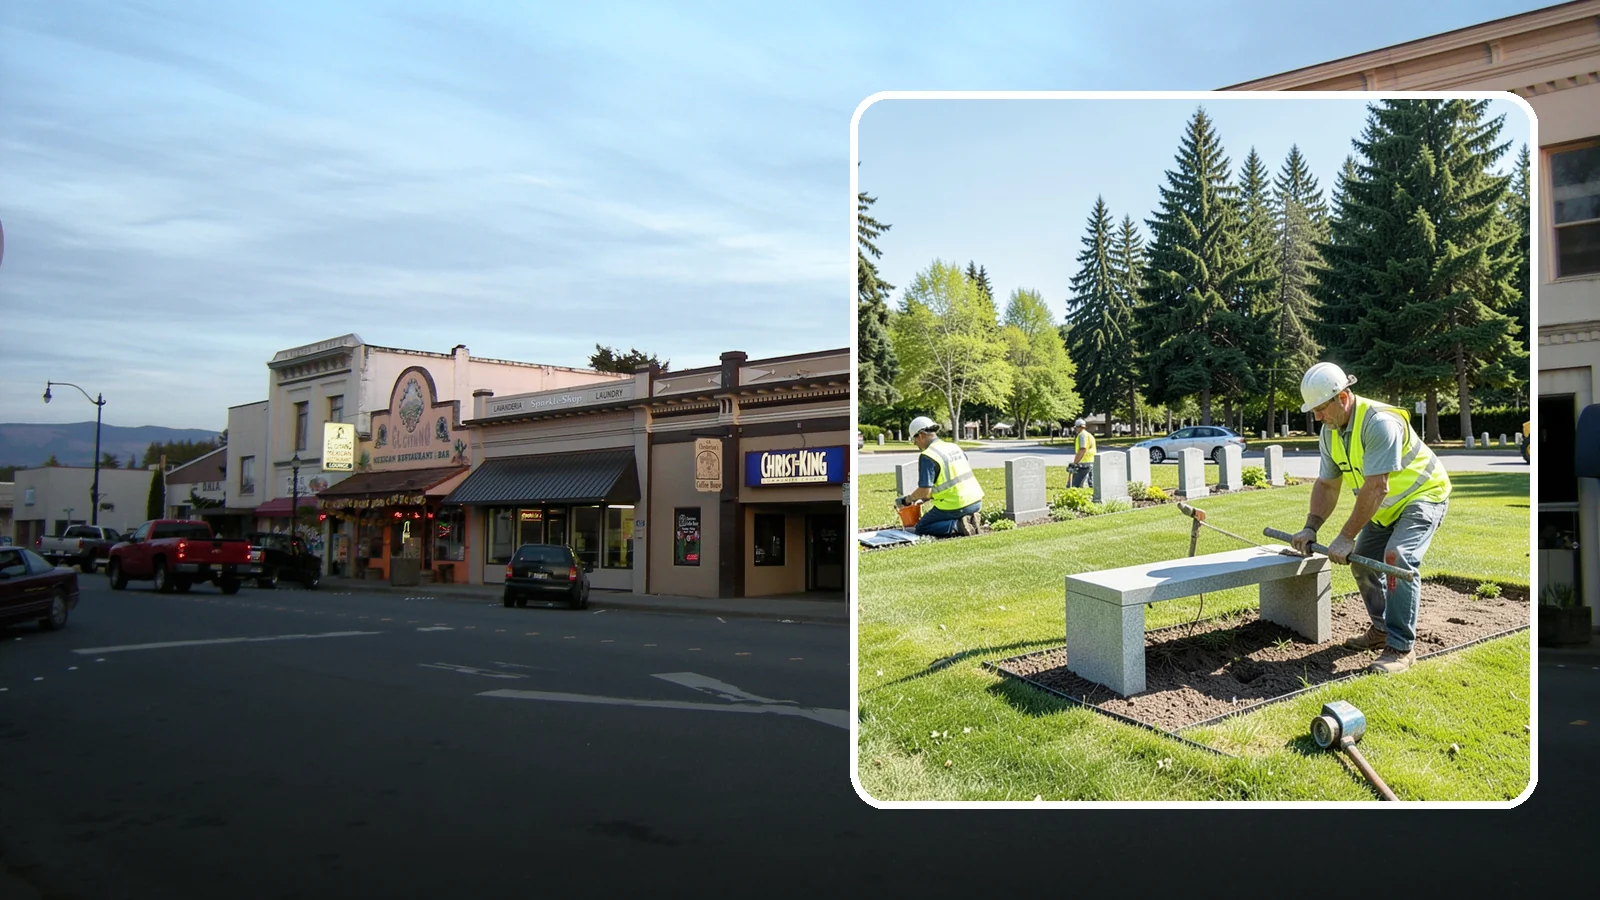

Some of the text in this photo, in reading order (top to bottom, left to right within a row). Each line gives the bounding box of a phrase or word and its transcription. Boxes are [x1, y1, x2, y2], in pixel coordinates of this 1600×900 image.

[595, 389, 623, 400] LAUNDRY
[493, 402, 522, 412] LAVANDERIA
[530, 394, 582, 409] Sparkle Shop
[397, 451, 433, 462] RESTAURANT
[437, 450, 450, 459] BAR
[761, 450, 827, 478] CHRIST KING
